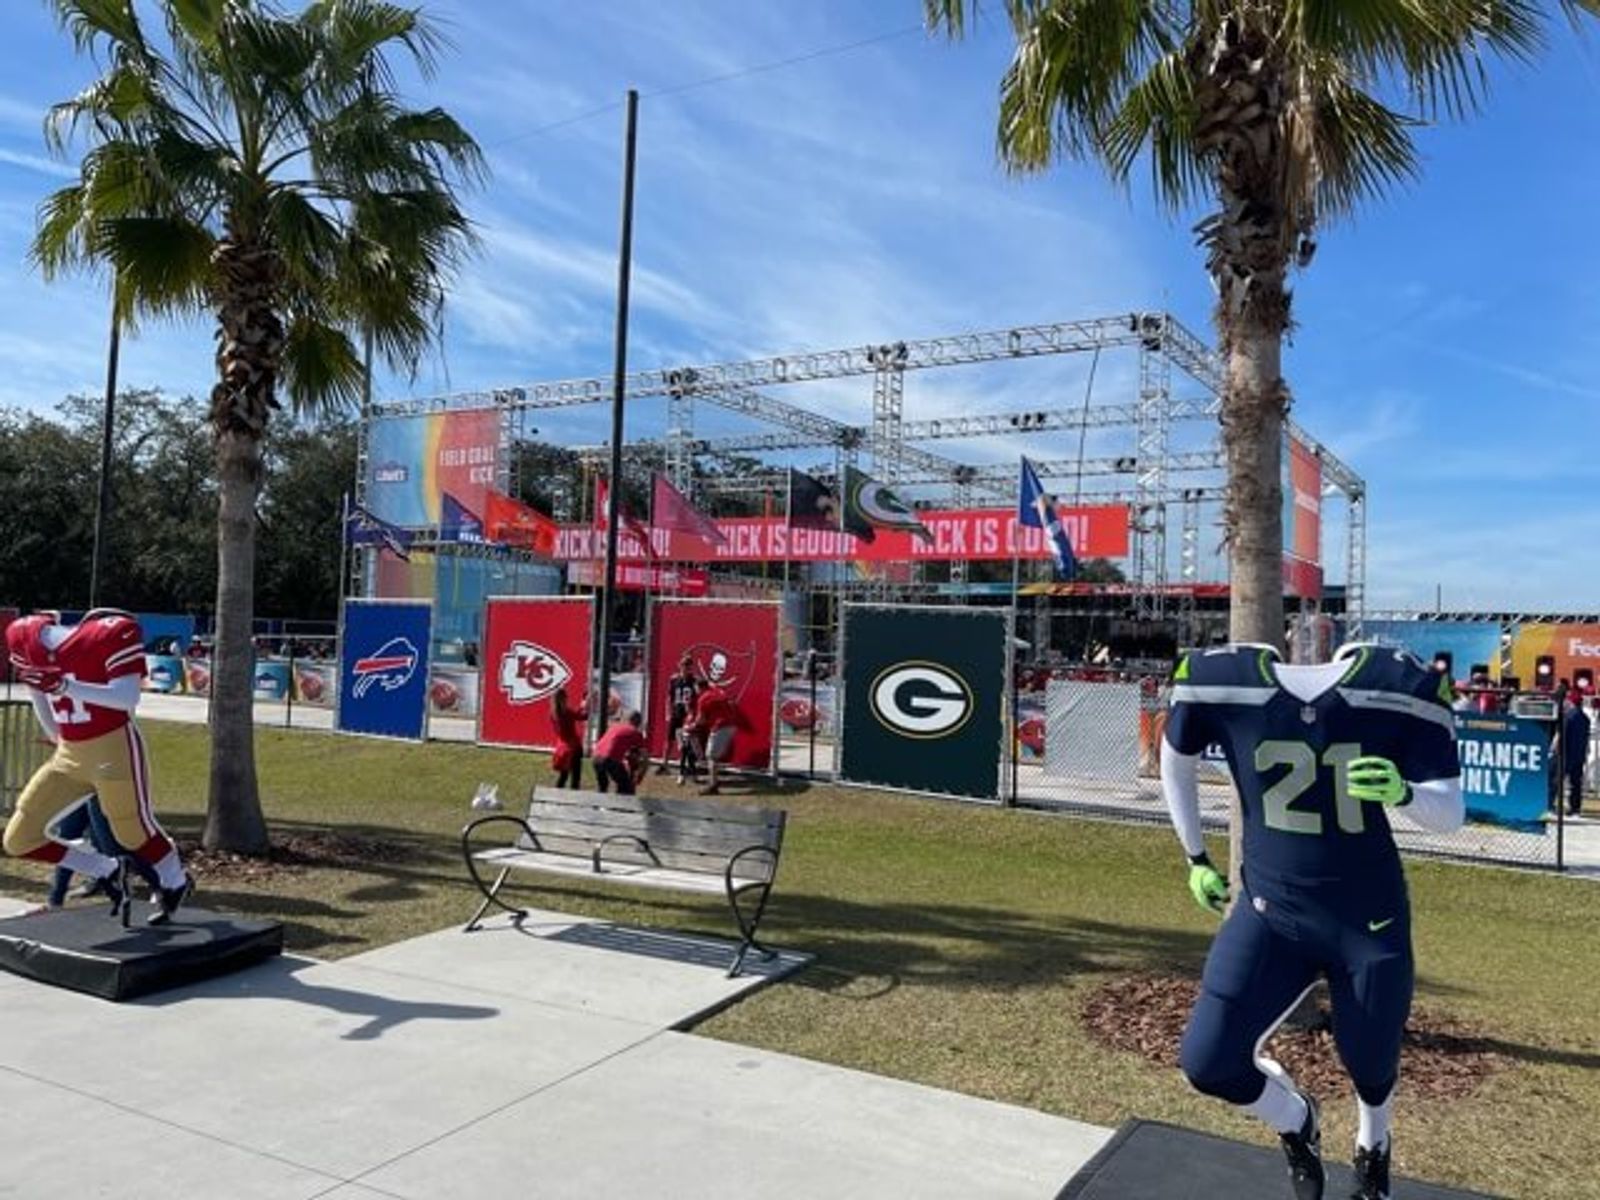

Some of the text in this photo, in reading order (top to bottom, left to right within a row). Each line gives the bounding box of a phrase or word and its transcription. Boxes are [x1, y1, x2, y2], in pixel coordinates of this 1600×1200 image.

[716, 524, 762, 556] KICK
[767, 524, 787, 556] IS
[974, 517, 999, 554] IS
[875, 667, 967, 732] G
[1254, 739, 1366, 835] 21
